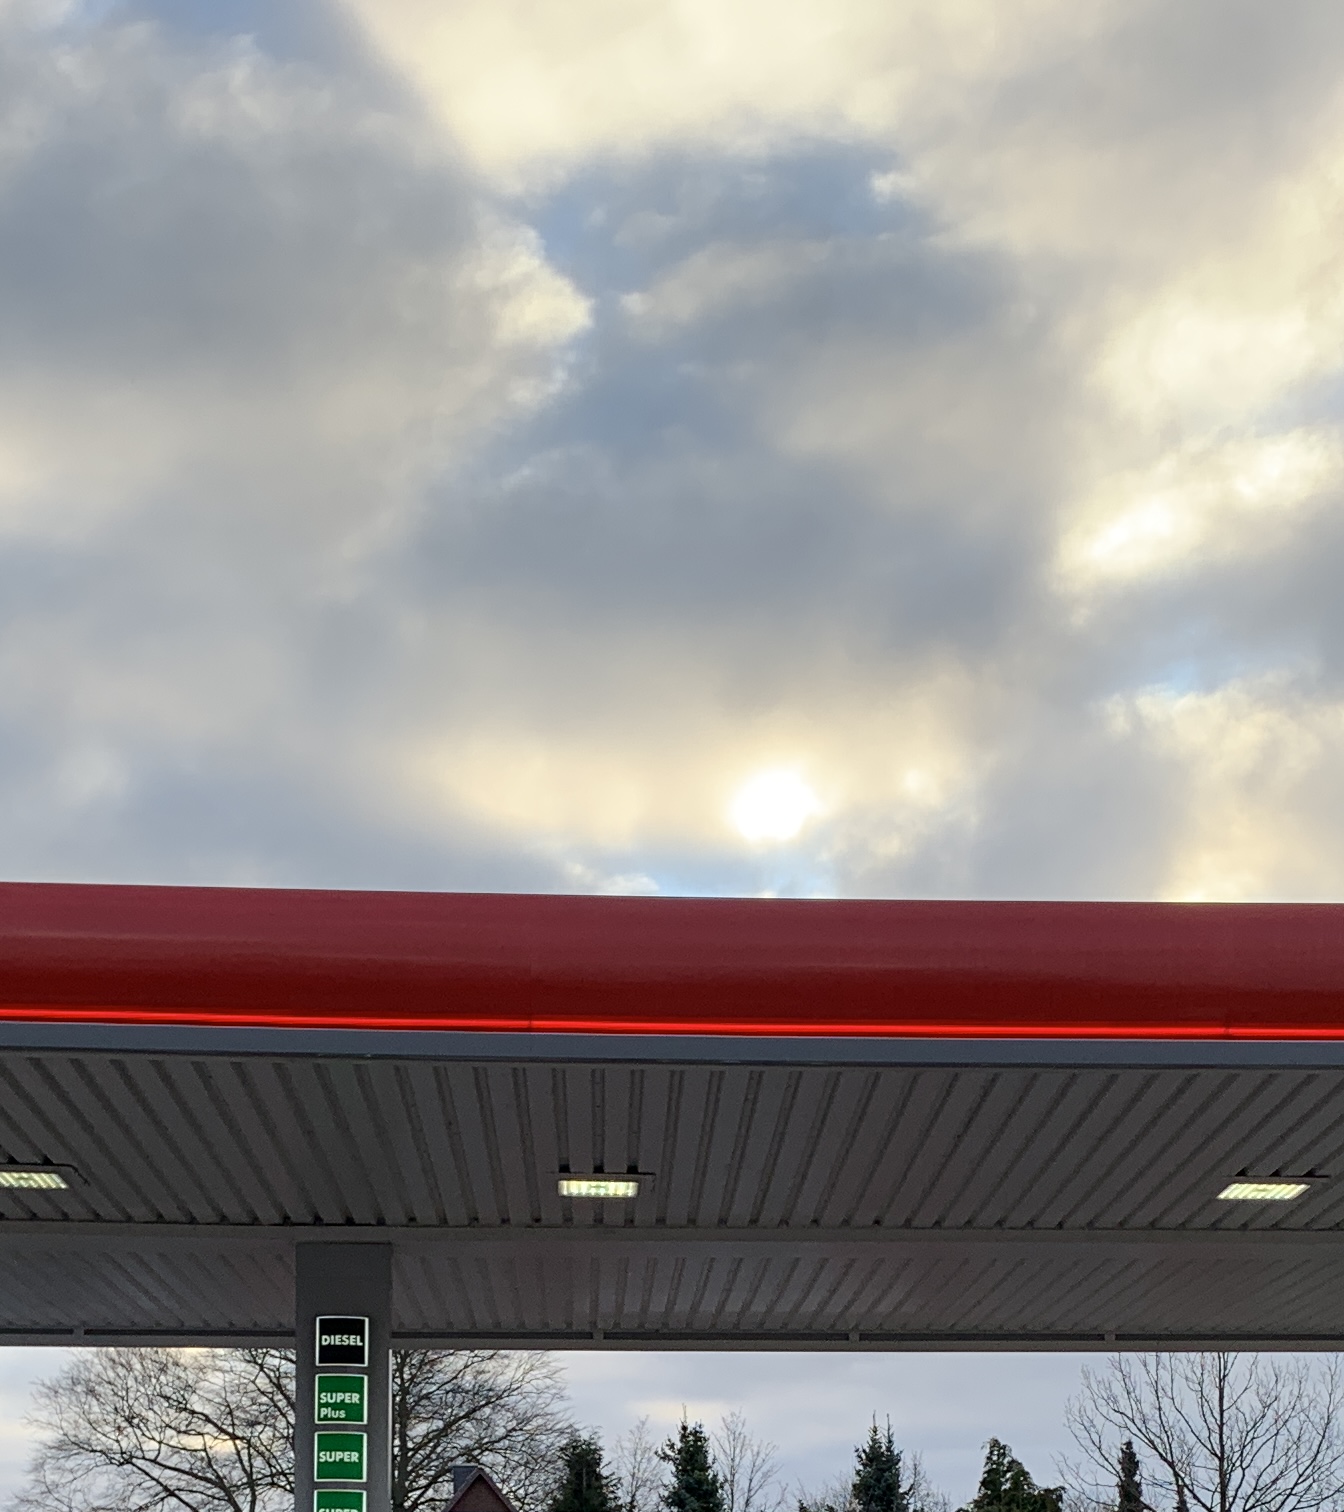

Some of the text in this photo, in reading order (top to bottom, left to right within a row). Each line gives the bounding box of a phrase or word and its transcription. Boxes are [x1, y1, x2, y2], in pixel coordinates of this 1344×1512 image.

[321, 1334, 363, 1346] DIESEL
[320, 1392, 360, 1404] SUPER
[320, 1407, 346, 1419] Plus
[319, 1451, 359, 1463] SUPER
